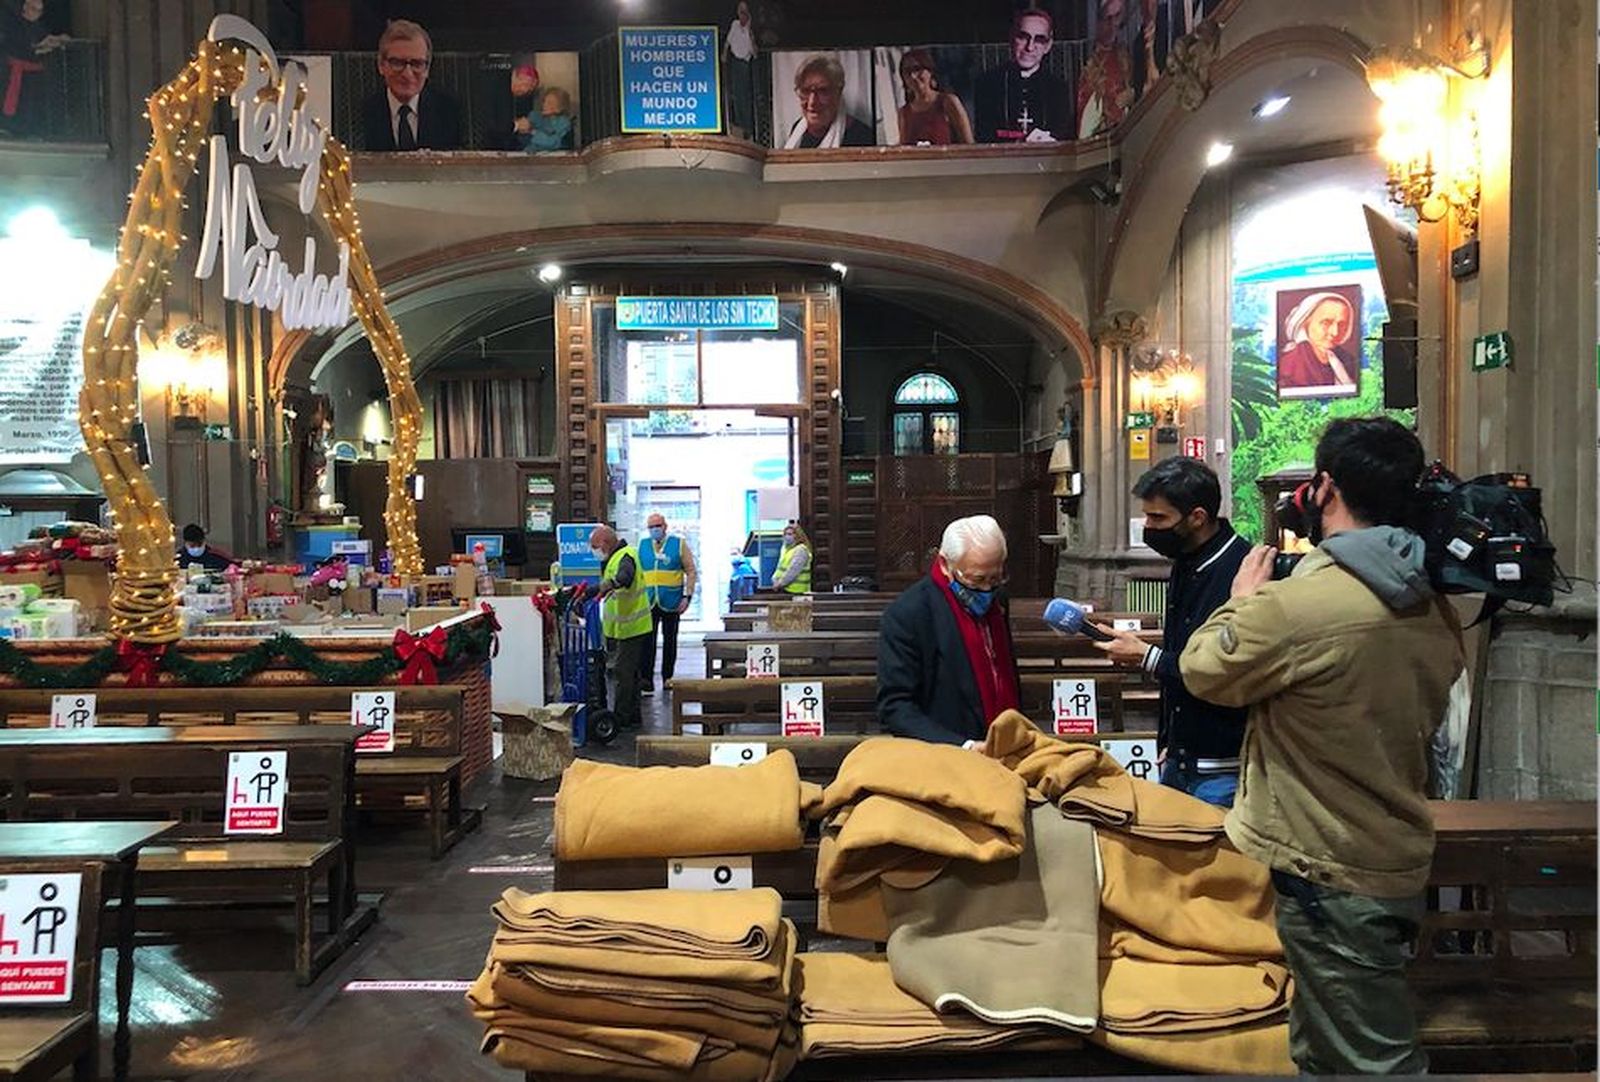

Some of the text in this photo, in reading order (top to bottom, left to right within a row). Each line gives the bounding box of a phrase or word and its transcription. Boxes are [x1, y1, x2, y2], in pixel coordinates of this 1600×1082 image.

[625, 35, 710, 46] MUJERES Y
[631, 50, 706, 62] HOMBRES
[652, 66, 685, 78] QUE
[631, 82, 708, 93] HACEN UN
[642, 97, 698, 109] MUNDO
[644, 113, 697, 124] MEJOR
[634, 301, 669, 323] PUERTA
[669, 301, 698, 323] SANTA
[699, 301, 711, 323] DE
[712, 301, 729, 323] LOS
[730, 301, 746, 323] SIN
[22, 966, 65, 977] PUEDES
[1, 980, 55, 992] SENTARTE
